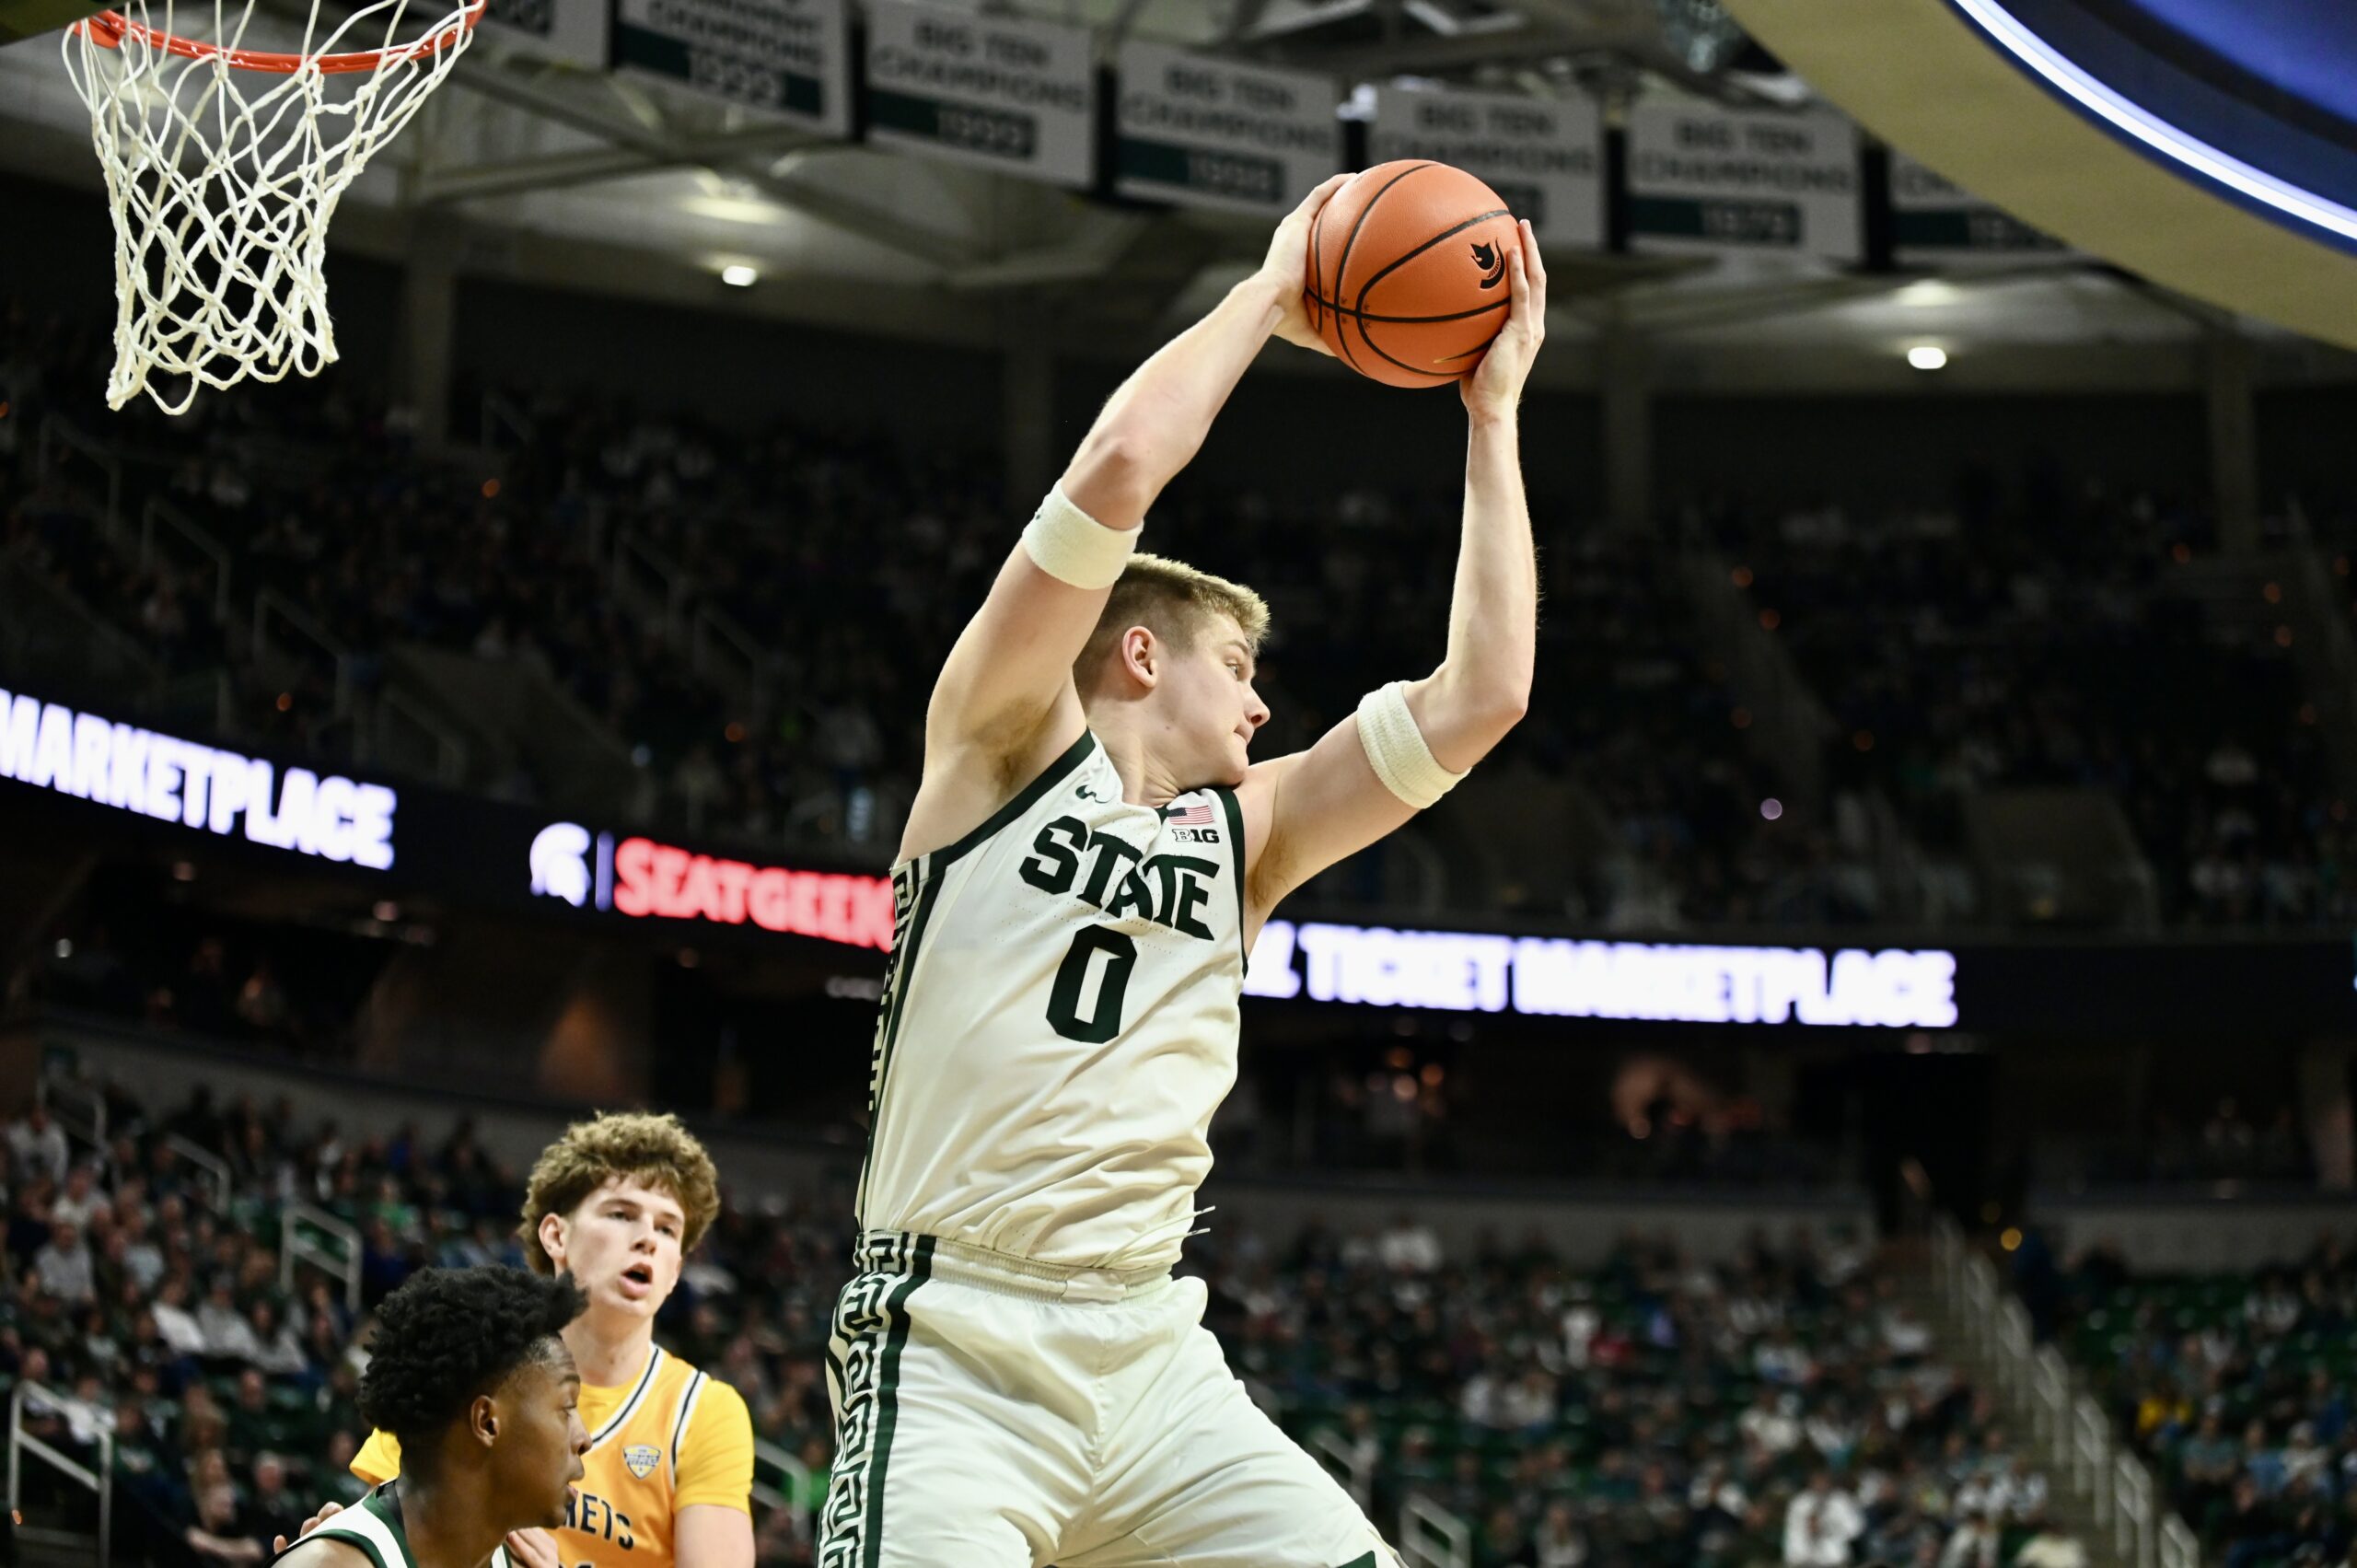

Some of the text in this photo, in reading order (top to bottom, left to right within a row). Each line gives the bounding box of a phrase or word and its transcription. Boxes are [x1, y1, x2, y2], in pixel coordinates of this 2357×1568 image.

[914, 21, 1050, 67] BIG TEN
[870, 46, 1083, 113] CHAMPIONS
[1164, 65, 1295, 111] BIG TEN
[1120, 93, 1331, 156] CHAMPIONS
[1419, 101, 1555, 136] BIG TEN
[1674, 120, 1812, 155] BIG TEN
[1632, 151, 1847, 194] CHAMPIONS
[0, 688, 397, 871] MARKETPLACE
[1018, 815, 1221, 941] STATE
[1045, 923, 1138, 1044] 0
[1297, 923, 1512, 1013] TICKET
[1511, 935, 1958, 1028] MARKETPLACE
